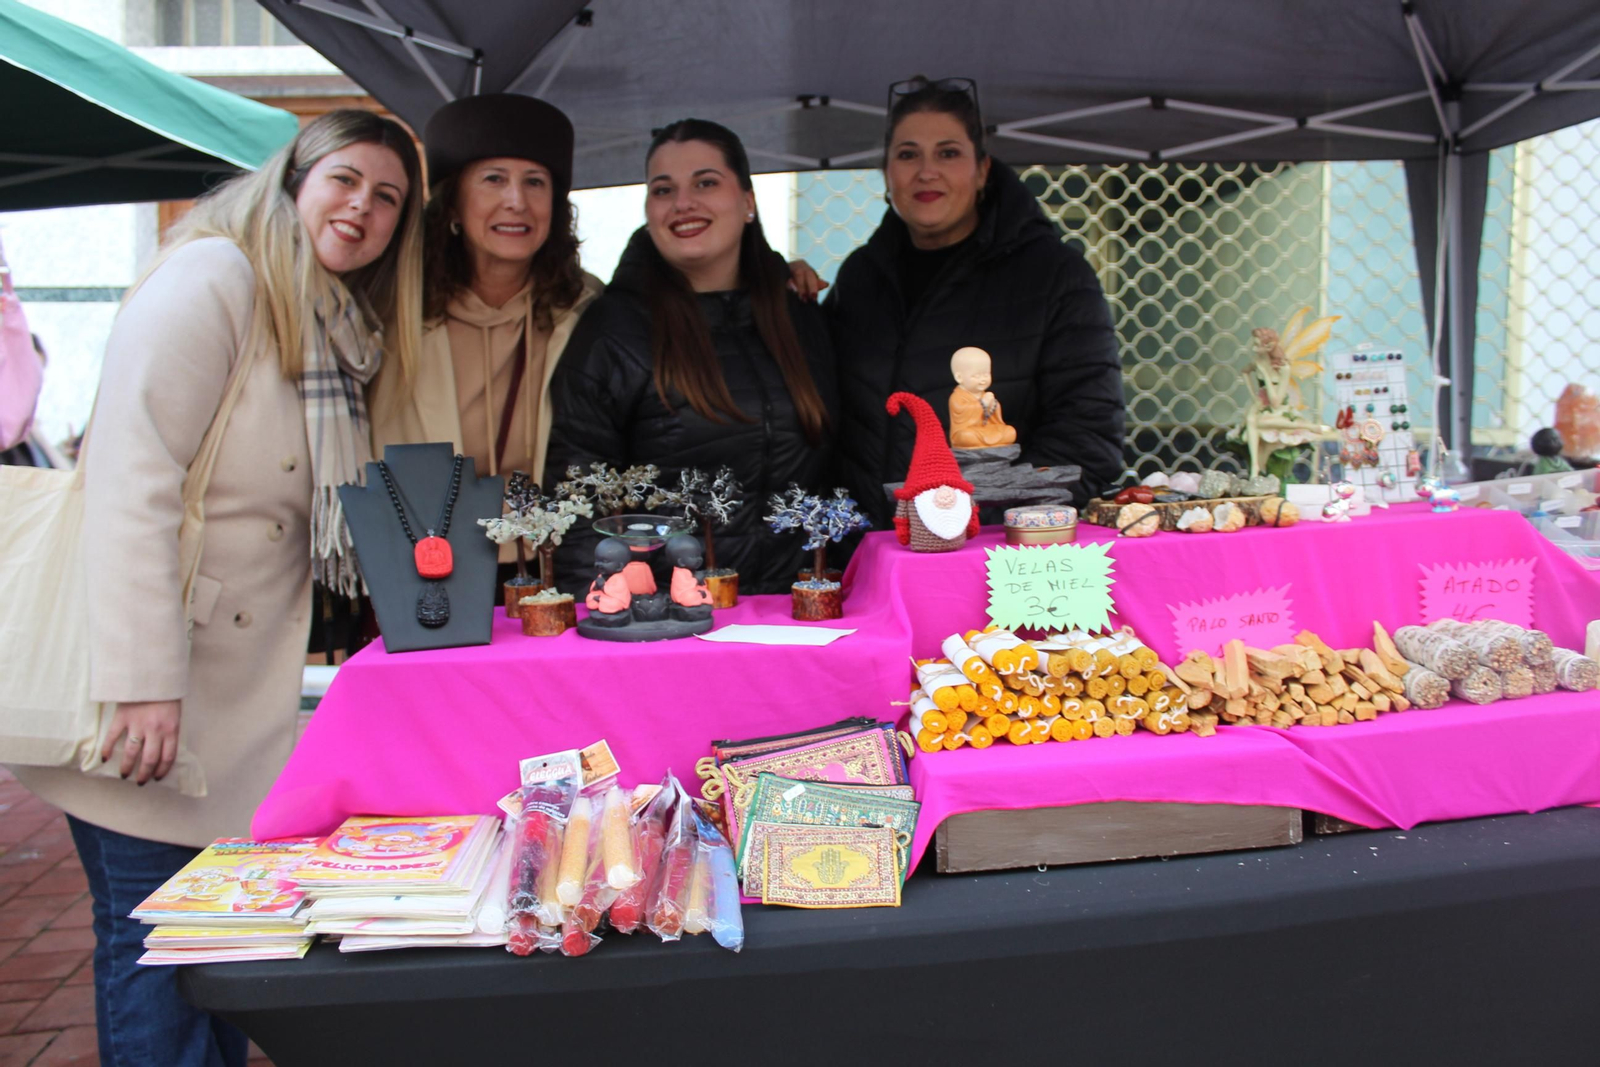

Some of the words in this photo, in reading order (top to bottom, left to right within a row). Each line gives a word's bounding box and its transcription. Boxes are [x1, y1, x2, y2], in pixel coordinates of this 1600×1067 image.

[1005, 557, 1074, 576] VELAS
[1004, 581, 1033, 595] DE
[1047, 577, 1095, 592] MIEL
[1443, 575, 1520, 594] ATADO
[1024, 595, 1071, 618] 3€
[1187, 617, 1227, 633] PALO
[1239, 611, 1280, 629] SANTO
